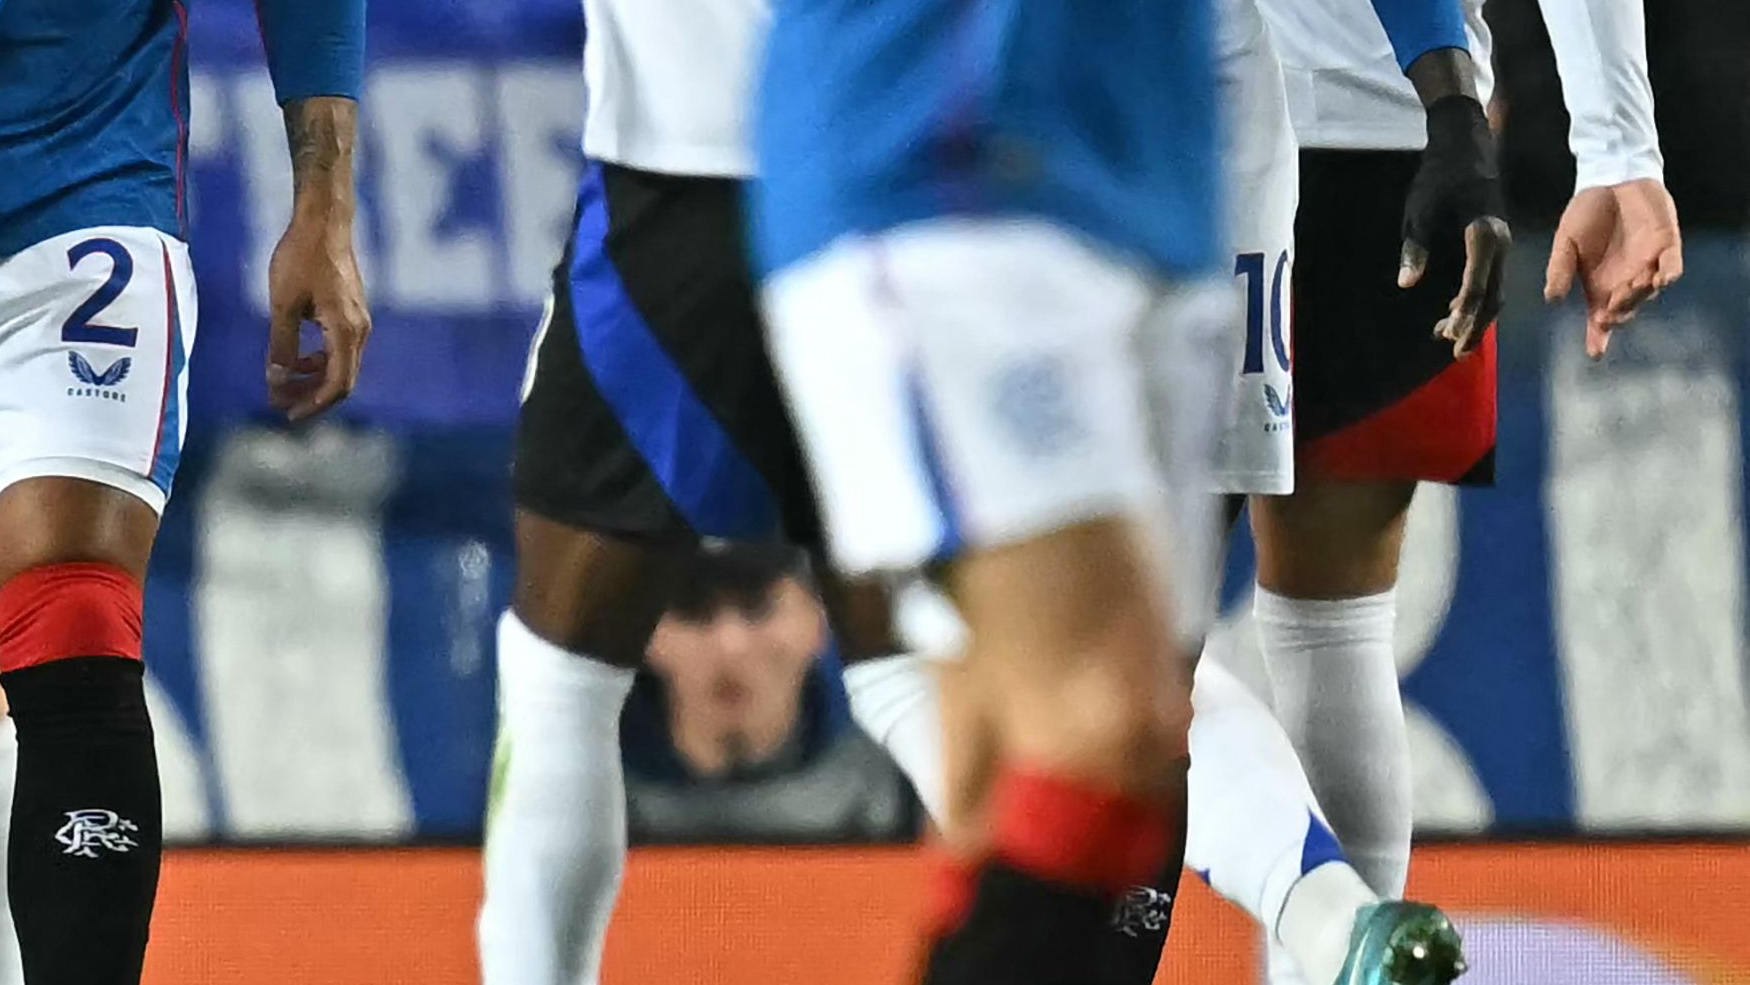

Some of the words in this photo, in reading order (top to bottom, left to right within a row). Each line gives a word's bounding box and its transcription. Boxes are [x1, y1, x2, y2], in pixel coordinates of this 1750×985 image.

[61, 237, 139, 348] 2
[1234, 249, 1291, 375] 10
[66, 387, 127, 404] CASTORE
